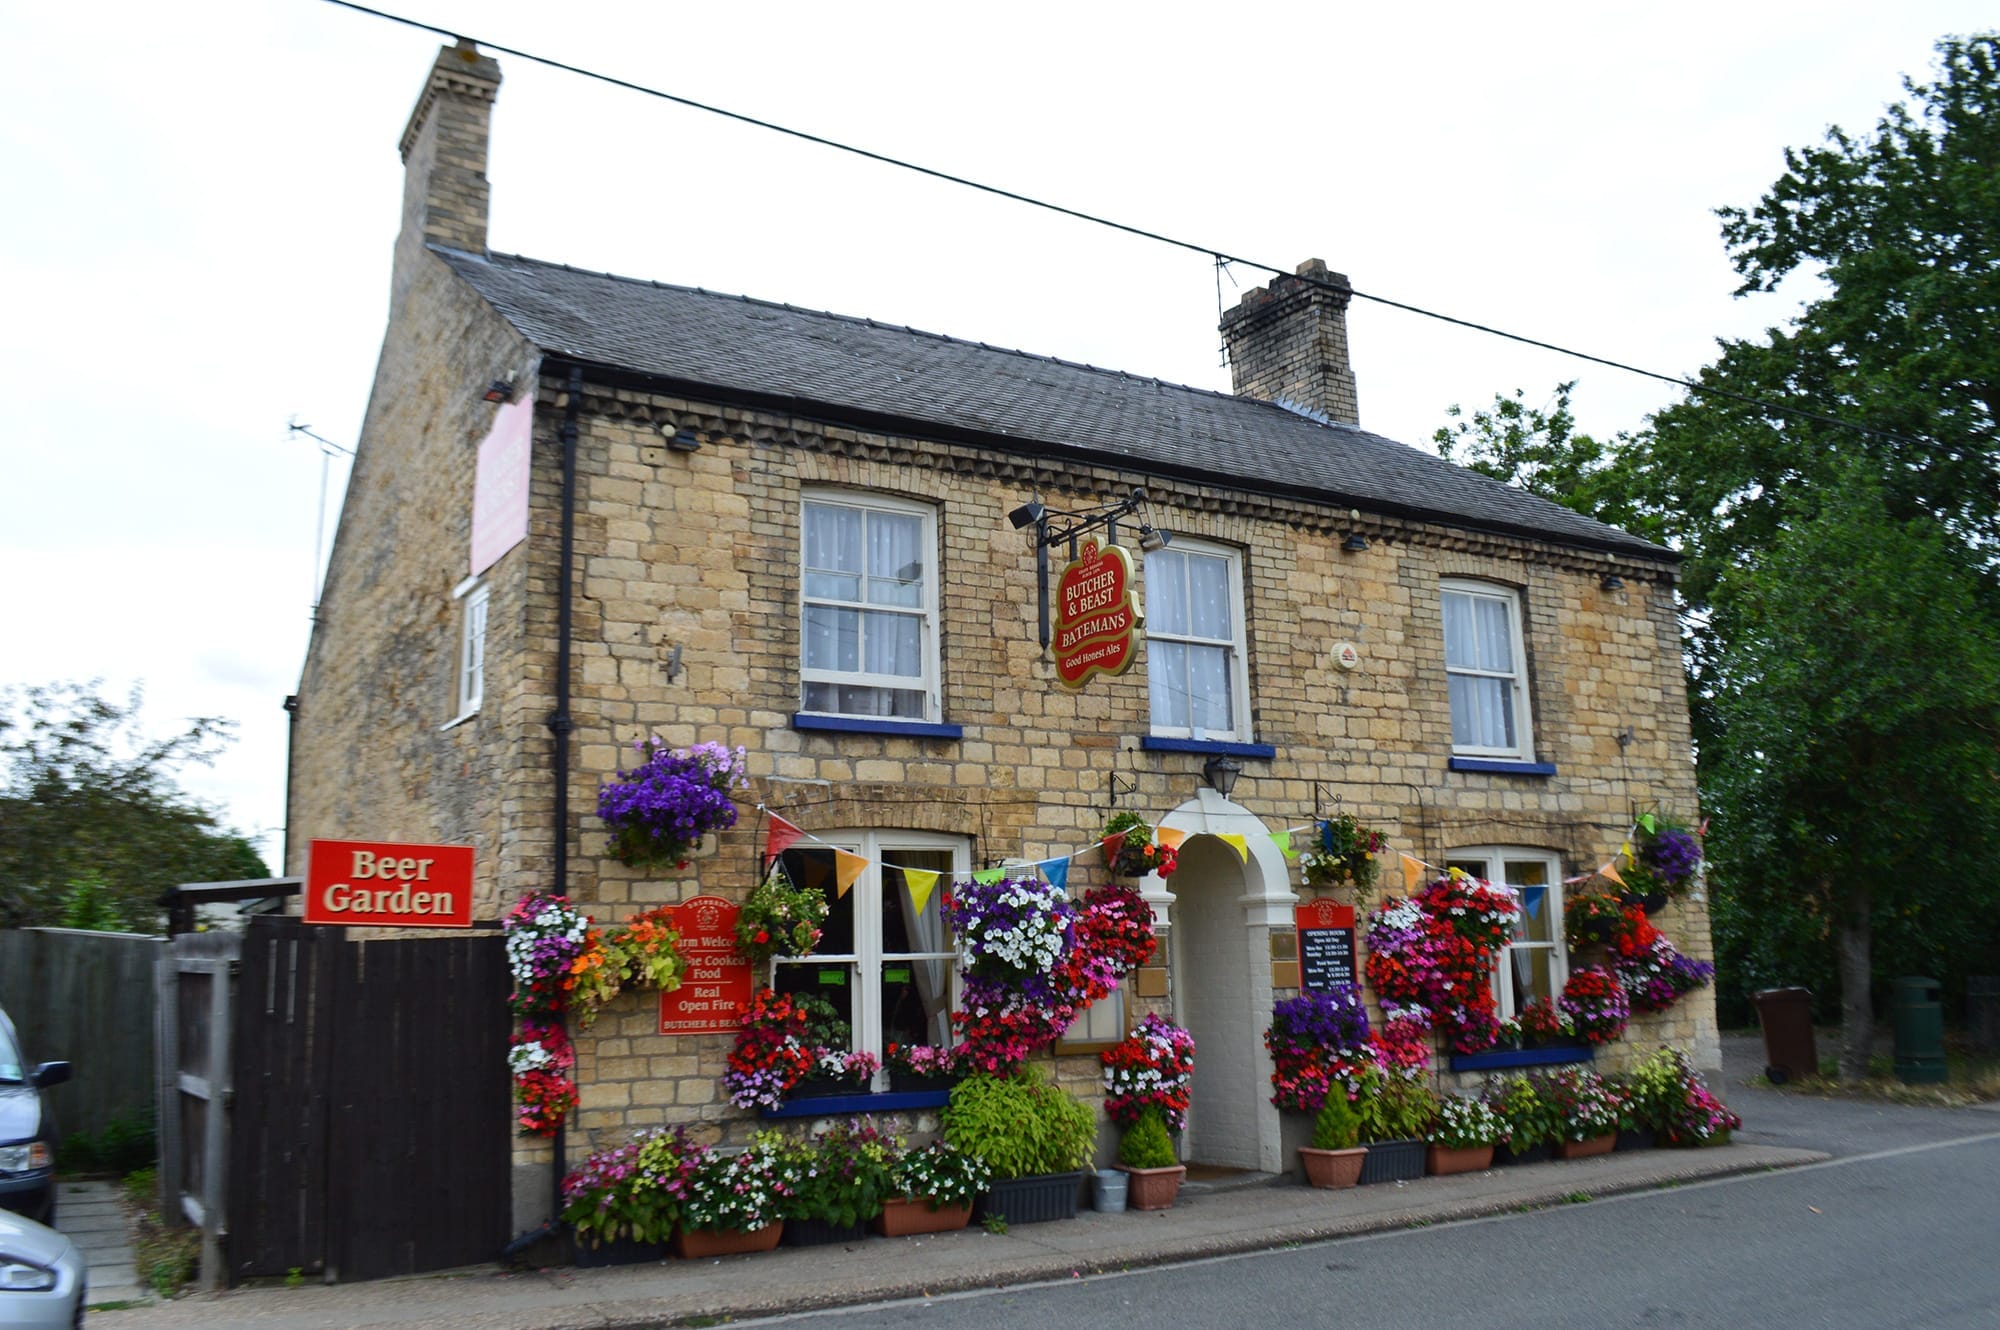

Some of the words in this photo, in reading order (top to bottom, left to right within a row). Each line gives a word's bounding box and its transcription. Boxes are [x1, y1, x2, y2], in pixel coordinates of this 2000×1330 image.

[1066, 570, 1115, 601] BUTCHER
[1068, 602, 1078, 616] &
[1080, 587, 1114, 613] BEAST
[1062, 612, 1126, 648] BATEMANS
[1066, 654, 1081, 668] Good
[1082, 648, 1105, 663] Honest
[1106, 643, 1121, 656] Ales
[350, 850, 435, 881] Beer
[323, 883, 455, 915] Garden
[693, 968, 721, 979] Food
[704, 956, 745, 966] Cooked
[694, 986, 720, 998] Real
[678, 1000, 709, 1014] Open
[712, 1000, 735, 1010] Fire
[664, 1020, 708, 1029] BUTCHER
[709, 1020, 717, 1028] &
[719, 1019, 743, 1027] BEAS
